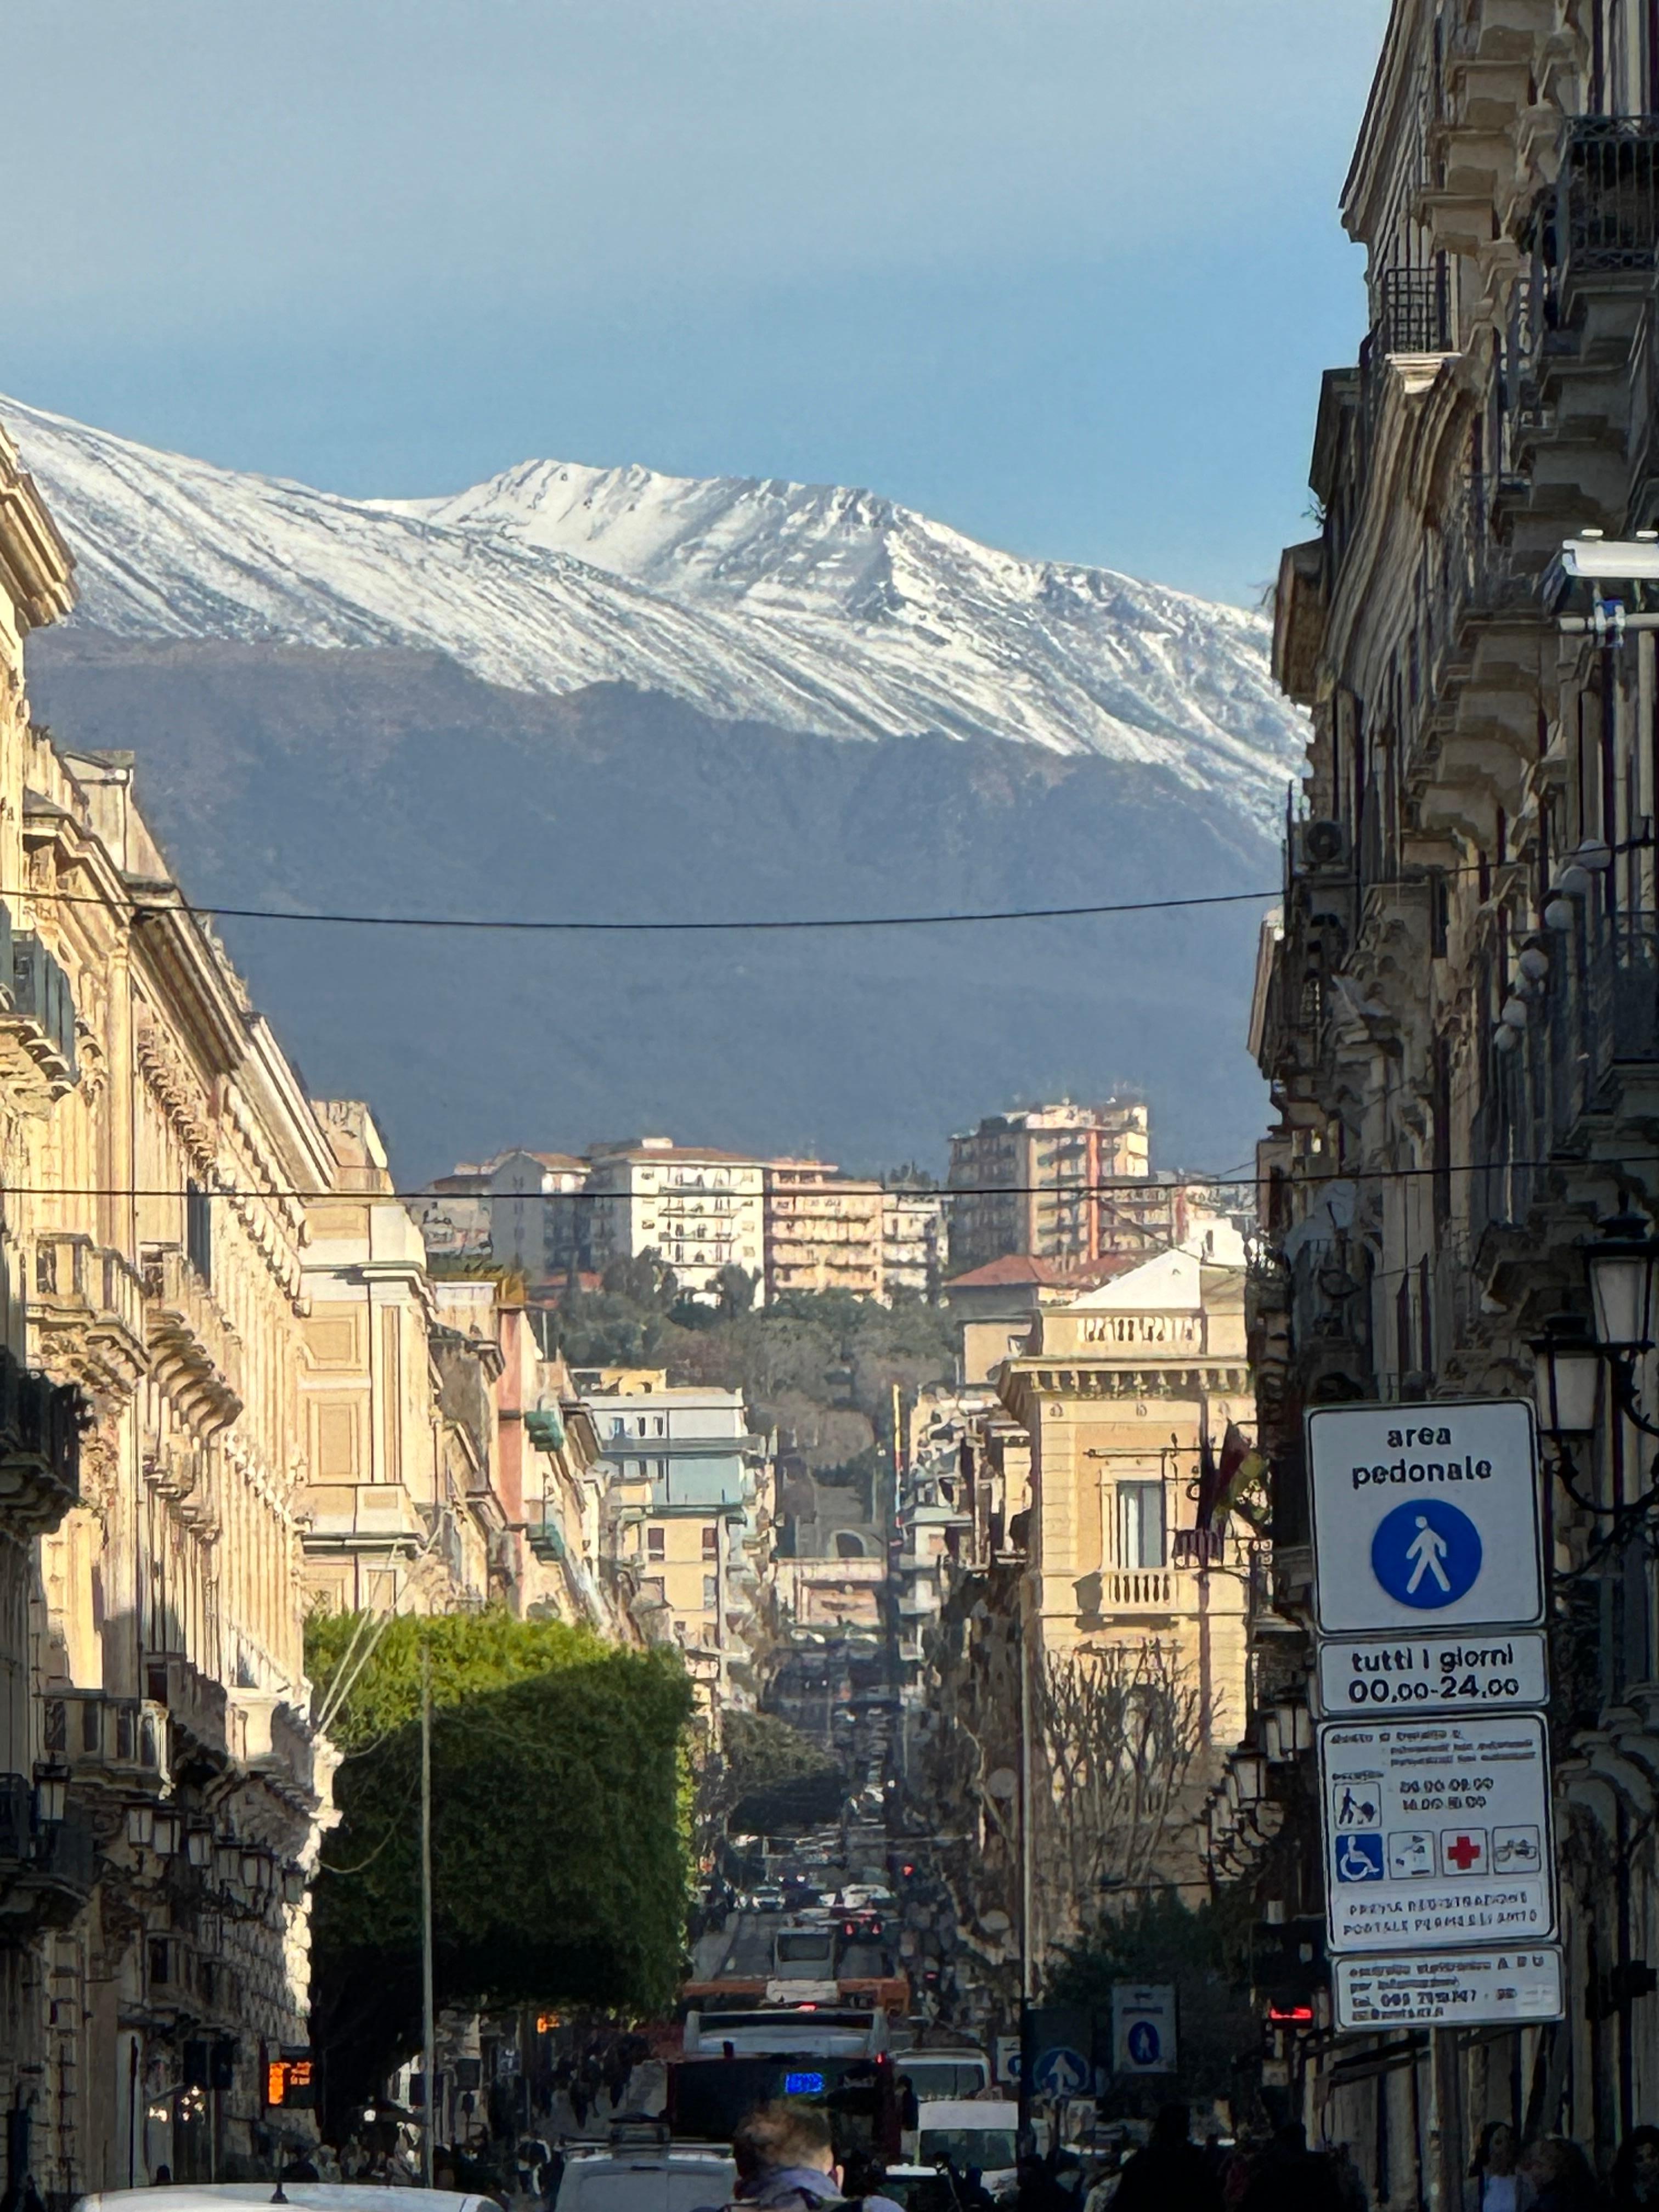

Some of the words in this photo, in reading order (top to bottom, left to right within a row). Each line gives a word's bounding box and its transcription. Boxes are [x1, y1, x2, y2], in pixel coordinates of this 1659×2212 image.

[1387, 1427, 1451, 1447] area
[1352, 1456, 1492, 1489] pedonale
[1352, 1647, 1413, 1672] tutti
[1440, 1644, 1513, 1673] giorni
